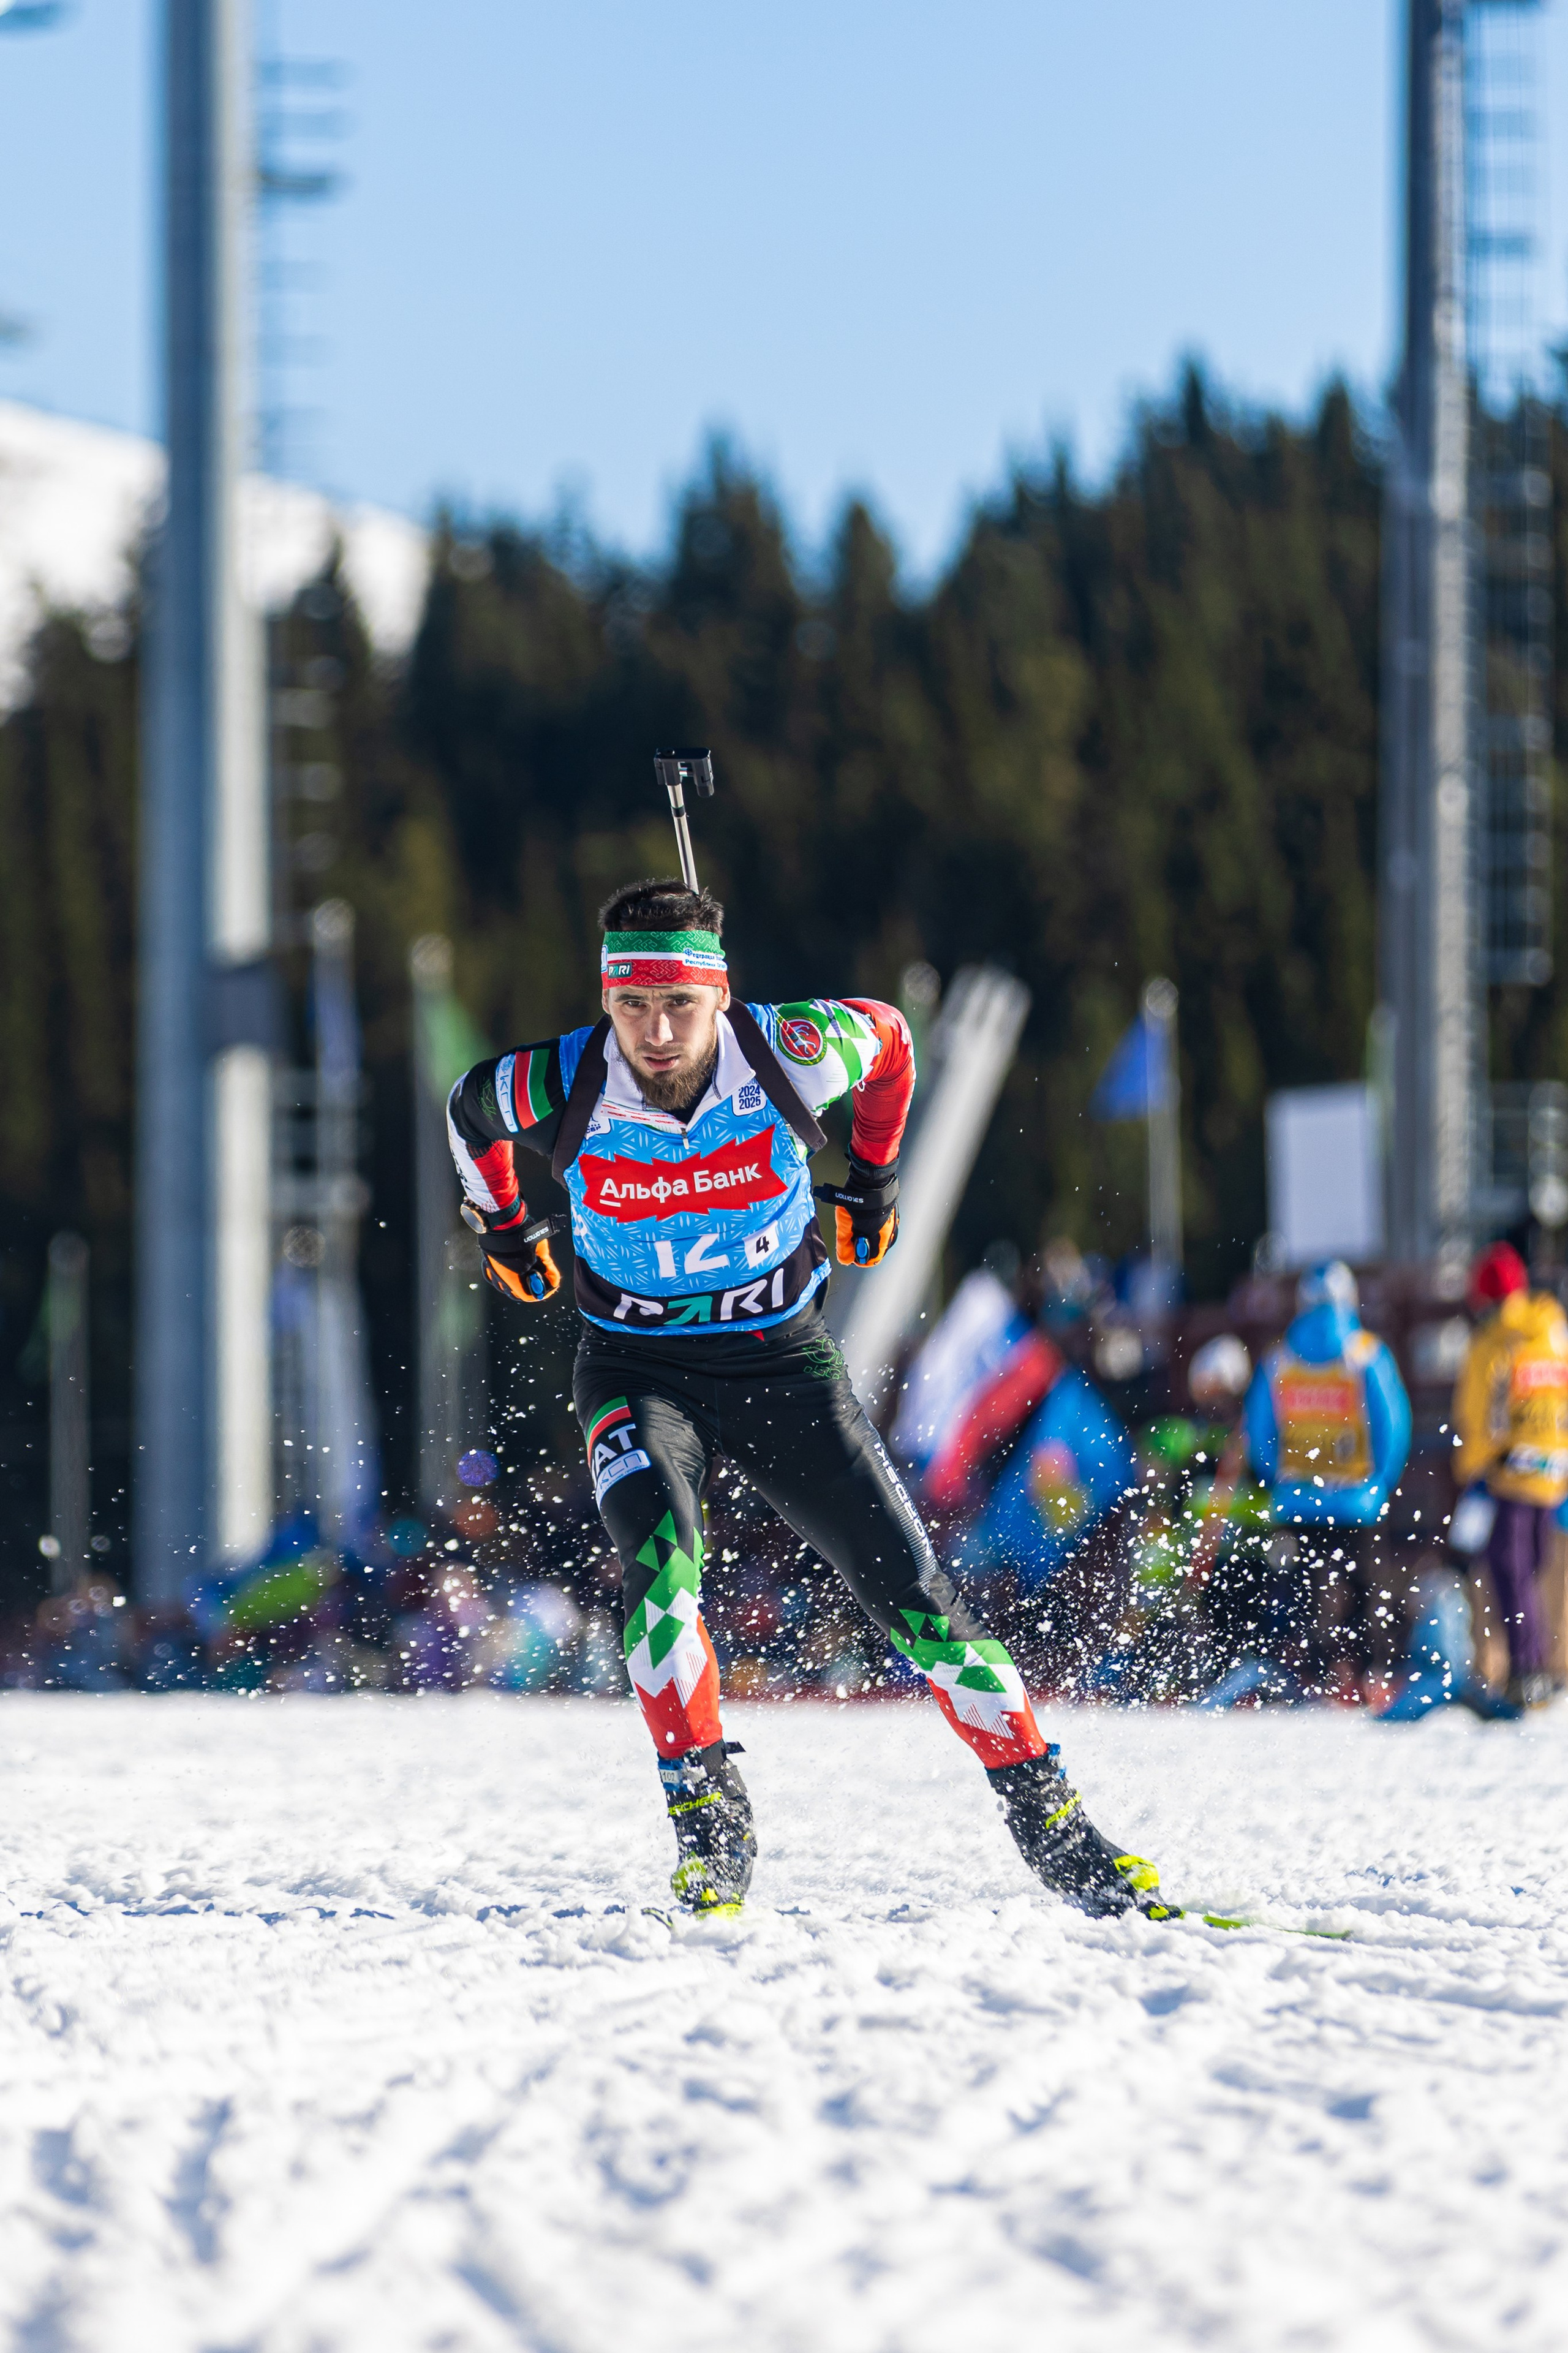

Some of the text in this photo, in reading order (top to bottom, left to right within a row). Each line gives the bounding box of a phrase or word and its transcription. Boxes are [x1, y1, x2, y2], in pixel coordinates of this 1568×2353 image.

[608, 965, 630, 976] PARI
[738, 1084, 761, 1098] 2024
[739, 1096, 761, 1110] 2025
[600, 1163, 762, 1207] Альфа Банк
[755, 1235, 769, 1254] 4
[613, 1267, 784, 1325] PARI
[873, 1442, 932, 1557] NORDSKI
[668, 1792, 722, 1816] ISCHER
